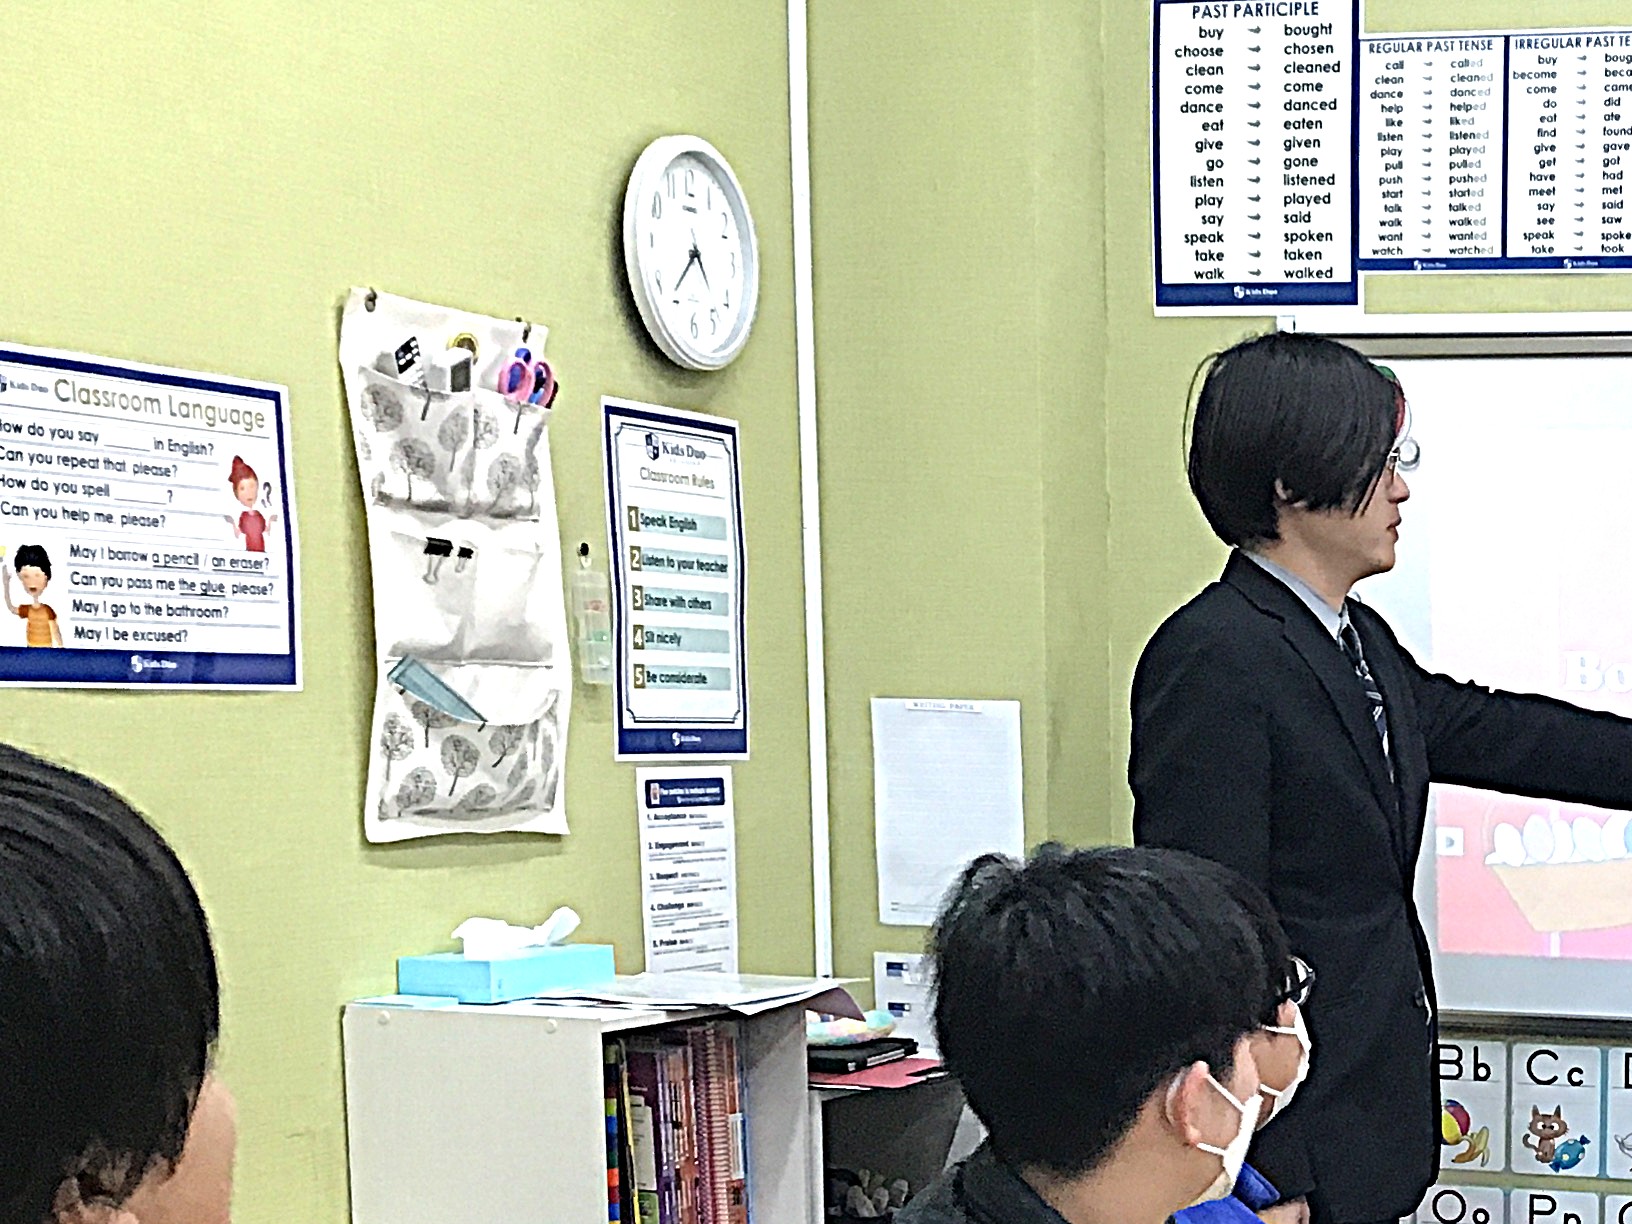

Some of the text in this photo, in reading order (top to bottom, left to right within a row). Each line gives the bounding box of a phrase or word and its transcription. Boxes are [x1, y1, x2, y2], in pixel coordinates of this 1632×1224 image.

[1192, 1, 1319, 19] PAST PARTICIPLE
[1199, 22, 1332, 40] buy bought
[1174, 42, 1334, 58] choose chosen
[1369, 39, 1493, 54] REGULAR PAST TENSE
[1515, 37, 1582, 50] IRREGULAR
[1586, 35, 1615, 48] PAST
[1185, 60, 1341, 76] clean cleaned
[1538, 55, 1558, 66] buy
[1184, 82, 1323, 95] come come
[1526, 86, 1557, 94] come
[1180, 98, 1337, 114] dance danced
[1543, 97, 1621, 109] do did
[1202, 117, 1323, 132] eat eaten
[1195, 136, 1321, 153] give given
[1206, 157, 1318, 172] go gone
[1190, 173, 1335, 188] listen listened
[1529, 170, 1623, 182] have had
[1195, 192, 1331, 209] play played
[1537, 199, 1624, 212] say said
[1201, 211, 1311, 227] say said
[1537, 216, 1622, 225] see saw
[1184, 229, 1333, 246] speak spoken
[1195, 248, 1322, 262] take taken
[1194, 266, 1333, 280] walk walked
[54, 378, 265, 431] Classroom Language
[661, 440, 707, 460] Kids Duo
[27, 449, 53, 465] you
[57, 451, 99, 470] repeat
[132, 461, 177, 478] please?
[0, 502, 29, 517] Can
[32, 506, 58, 521] you
[61, 504, 90, 524] help
[120, 512, 166, 529] please?
[71, 572, 96, 586] Can
[100, 575, 123, 591] you
[127, 577, 153, 591] pass
[156, 578, 176, 590] me
[179, 578, 197, 593] the
[232, 581, 274, 596] please?
[72, 600, 229, 620] May I go to the bathroom?
[74, 626, 188, 644] May I be excused?
[1438, 1044, 1492, 1082] Bb
[1526, 1049, 1588, 1087] Cc
